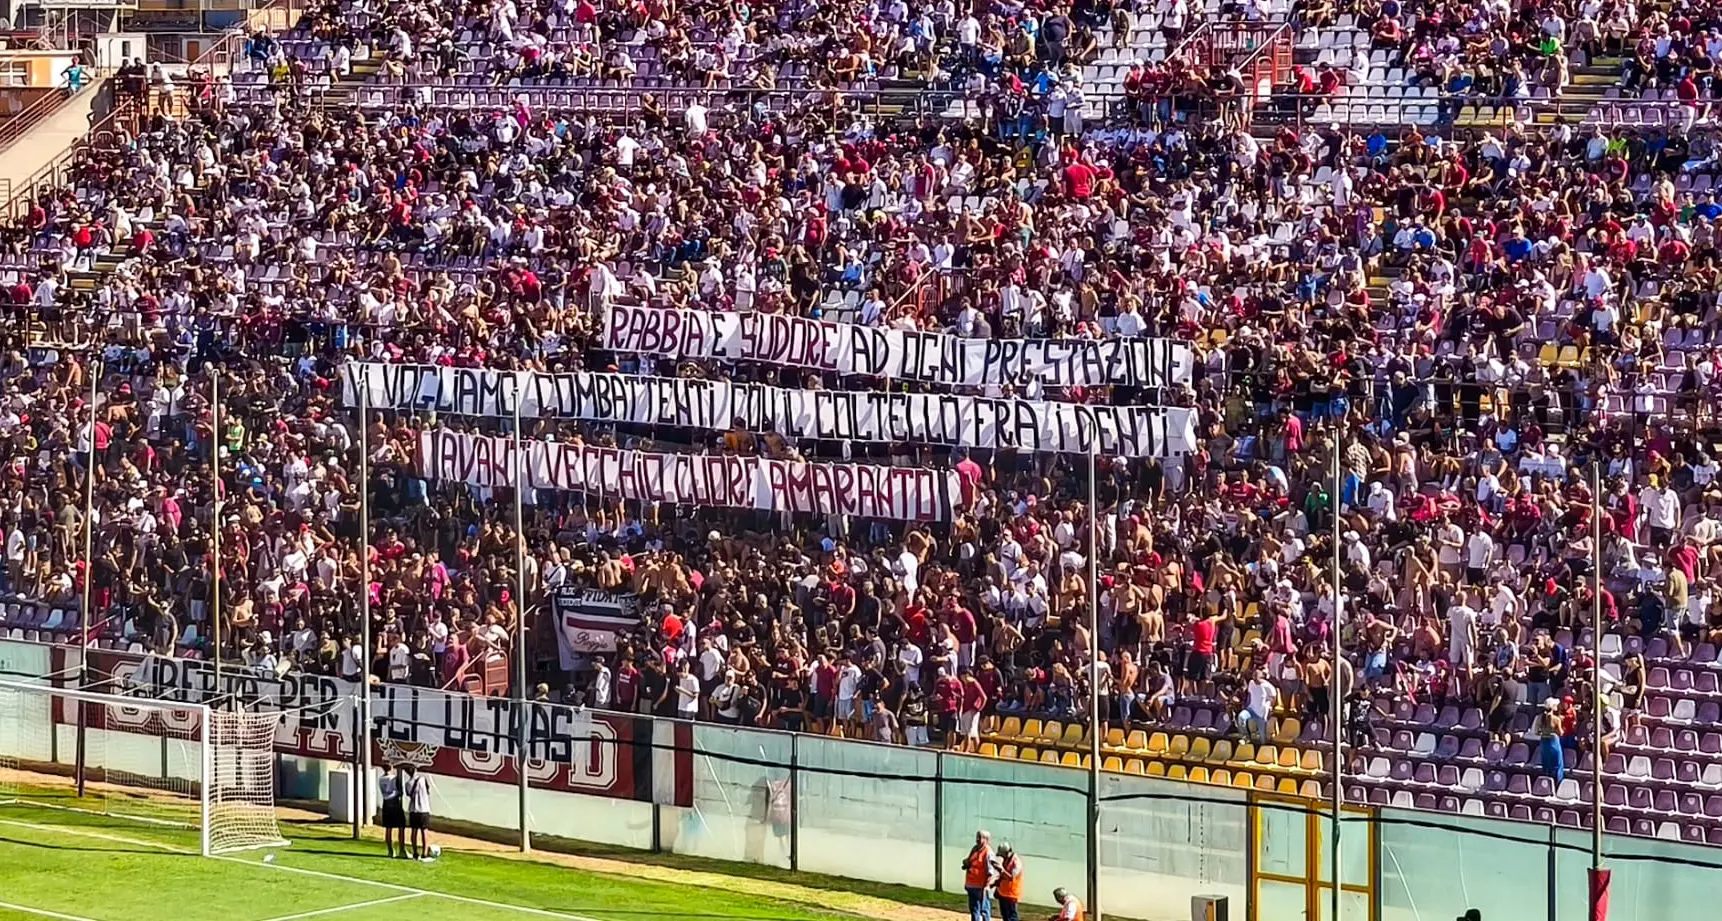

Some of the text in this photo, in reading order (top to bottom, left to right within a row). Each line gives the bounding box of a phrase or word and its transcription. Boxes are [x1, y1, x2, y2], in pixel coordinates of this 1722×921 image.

[713, 313, 727, 356] E
[741, 311, 838, 370] SUDORE
[851, 325, 889, 373] AD
[815, 391, 960, 444] COLTELLO
[974, 399, 1040, 448] FRA
[770, 462, 936, 520] AMARANTO
[280, 674, 339, 730] PER
[444, 694, 573, 763] ULTRAS
